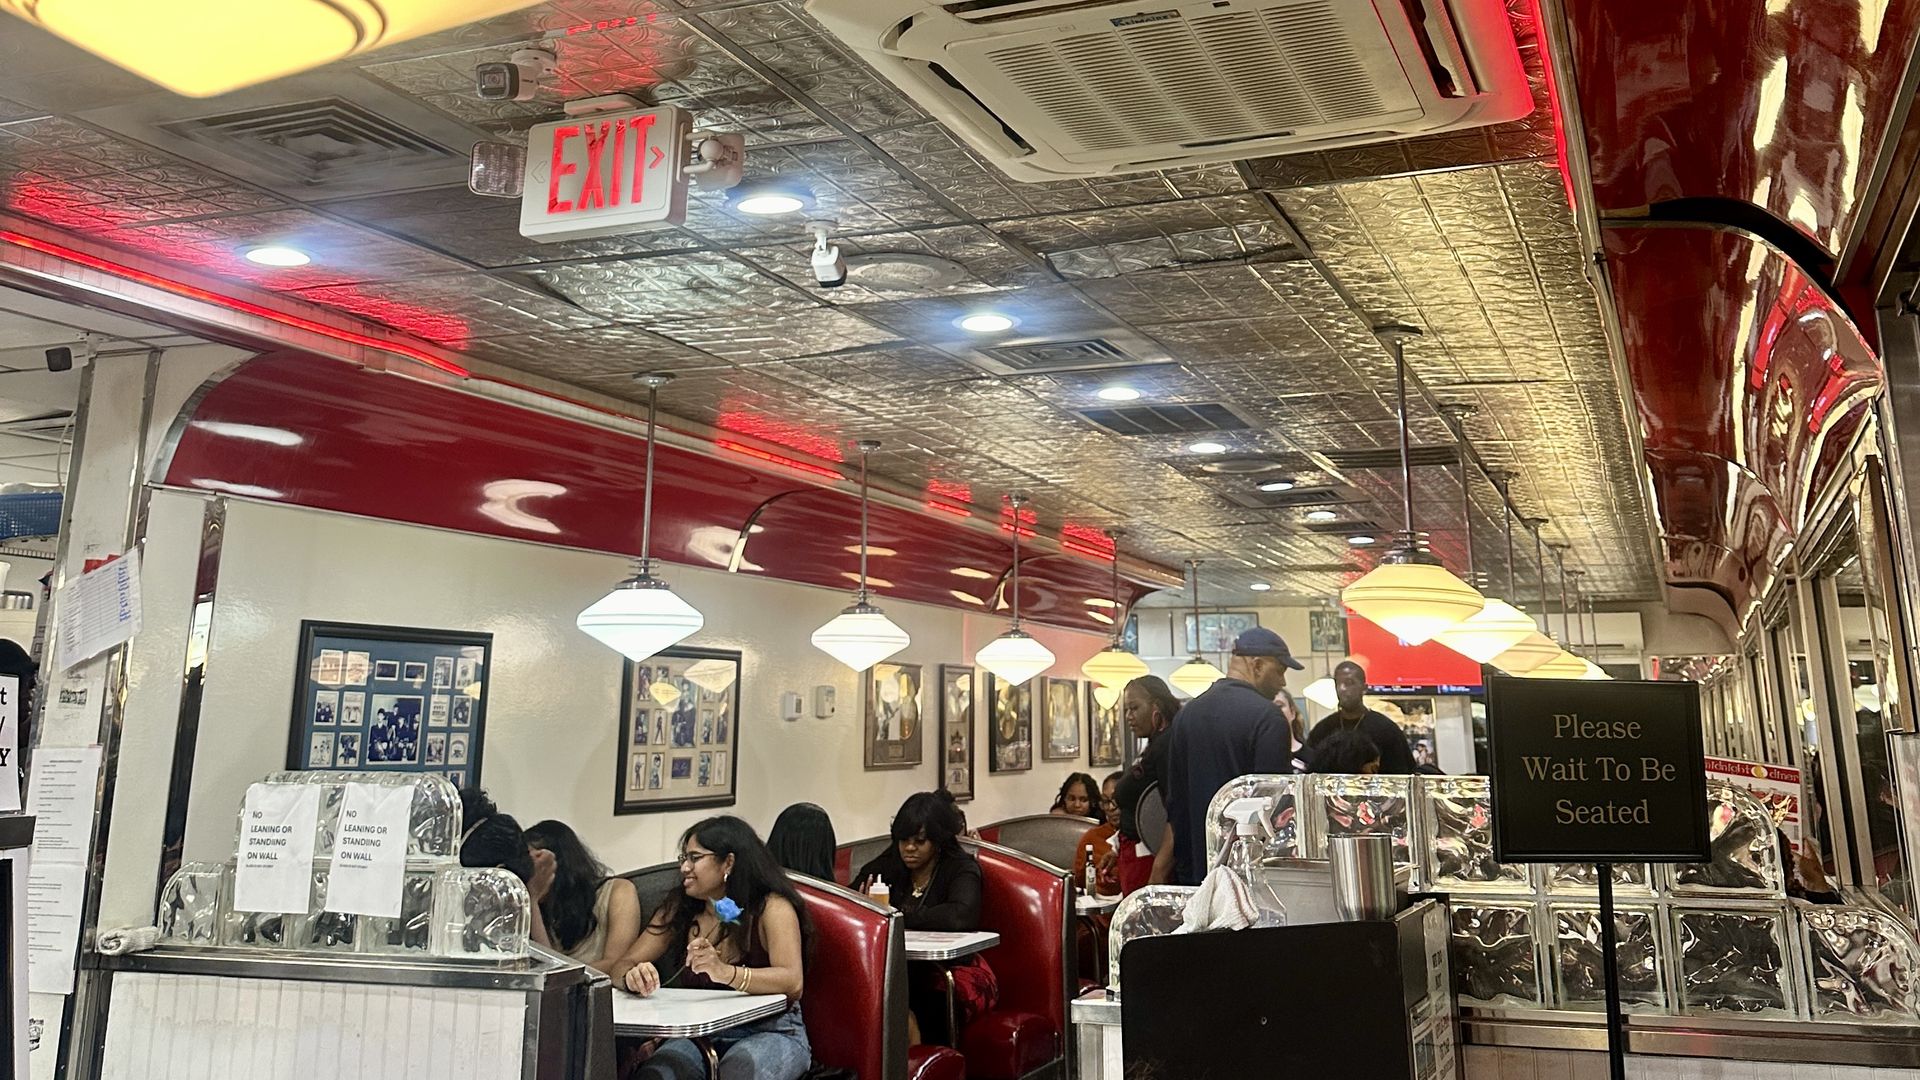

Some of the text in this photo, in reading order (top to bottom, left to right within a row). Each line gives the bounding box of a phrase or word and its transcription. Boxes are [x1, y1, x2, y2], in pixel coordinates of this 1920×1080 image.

[547, 114, 656, 215] EXIT
[1553, 713, 1642, 740] Please
[1521, 756, 1676, 781] Wait To Be
[252, 811, 263, 819] NO
[346, 810, 357, 818] NO
[1555, 799, 1650, 825] Seated
[250, 825, 292, 834] LEANING OR
[344, 824, 388, 834] LEANING OR
[247, 851, 279, 861] ON WALL
[340, 851, 373, 862] ON WALL
